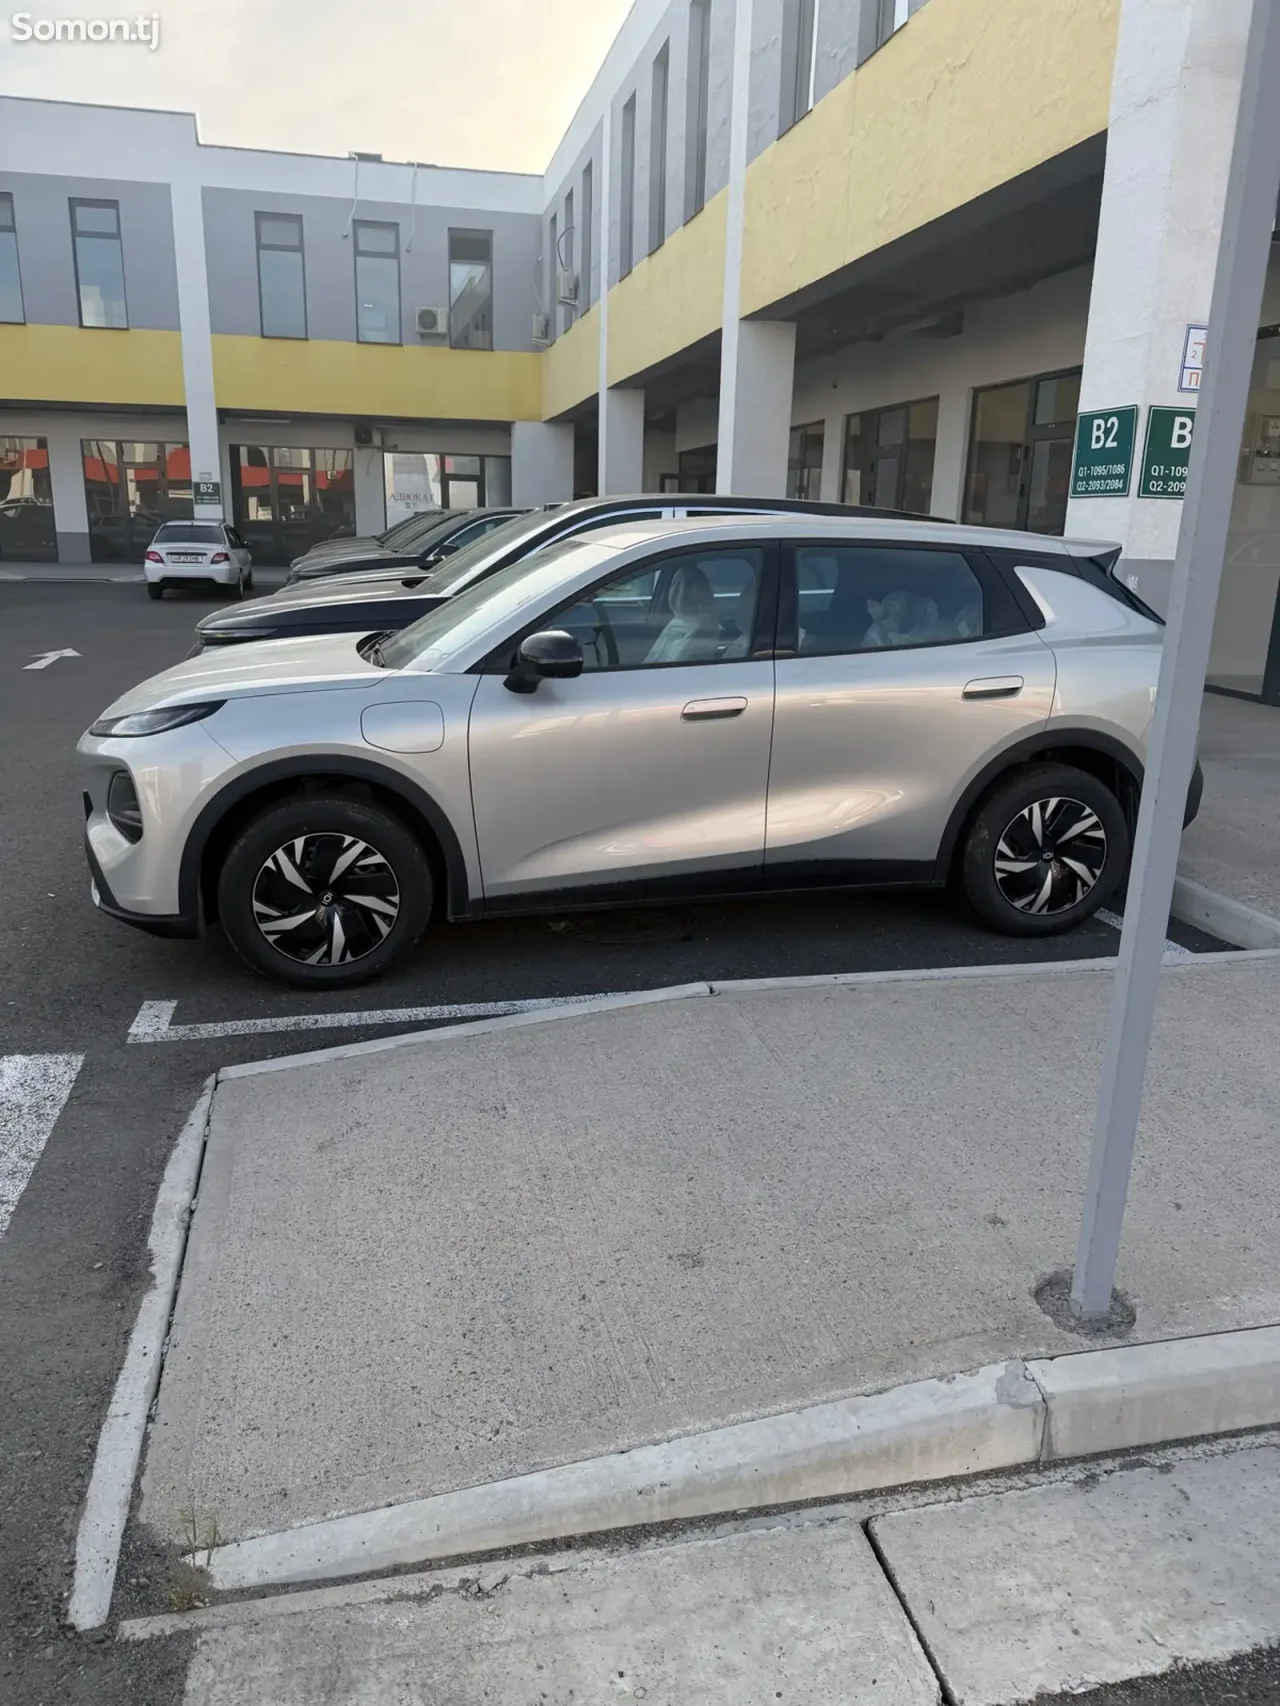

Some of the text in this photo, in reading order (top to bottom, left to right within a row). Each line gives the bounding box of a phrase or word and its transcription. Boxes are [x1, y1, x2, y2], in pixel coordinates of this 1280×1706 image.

[1188, 372, 1199, 387] П
[1090, 416, 1119, 450] B2
[1170, 416, 1193, 449] B
[1078, 464, 1125, 478] Q1-1095/1086
[1151, 465, 1188, 478] Q1-109
[199, 483, 214, 493] B2
[1076, 479, 1123, 492] Q2-2093/2084
[1149, 481, 1186, 493] Q2-209
